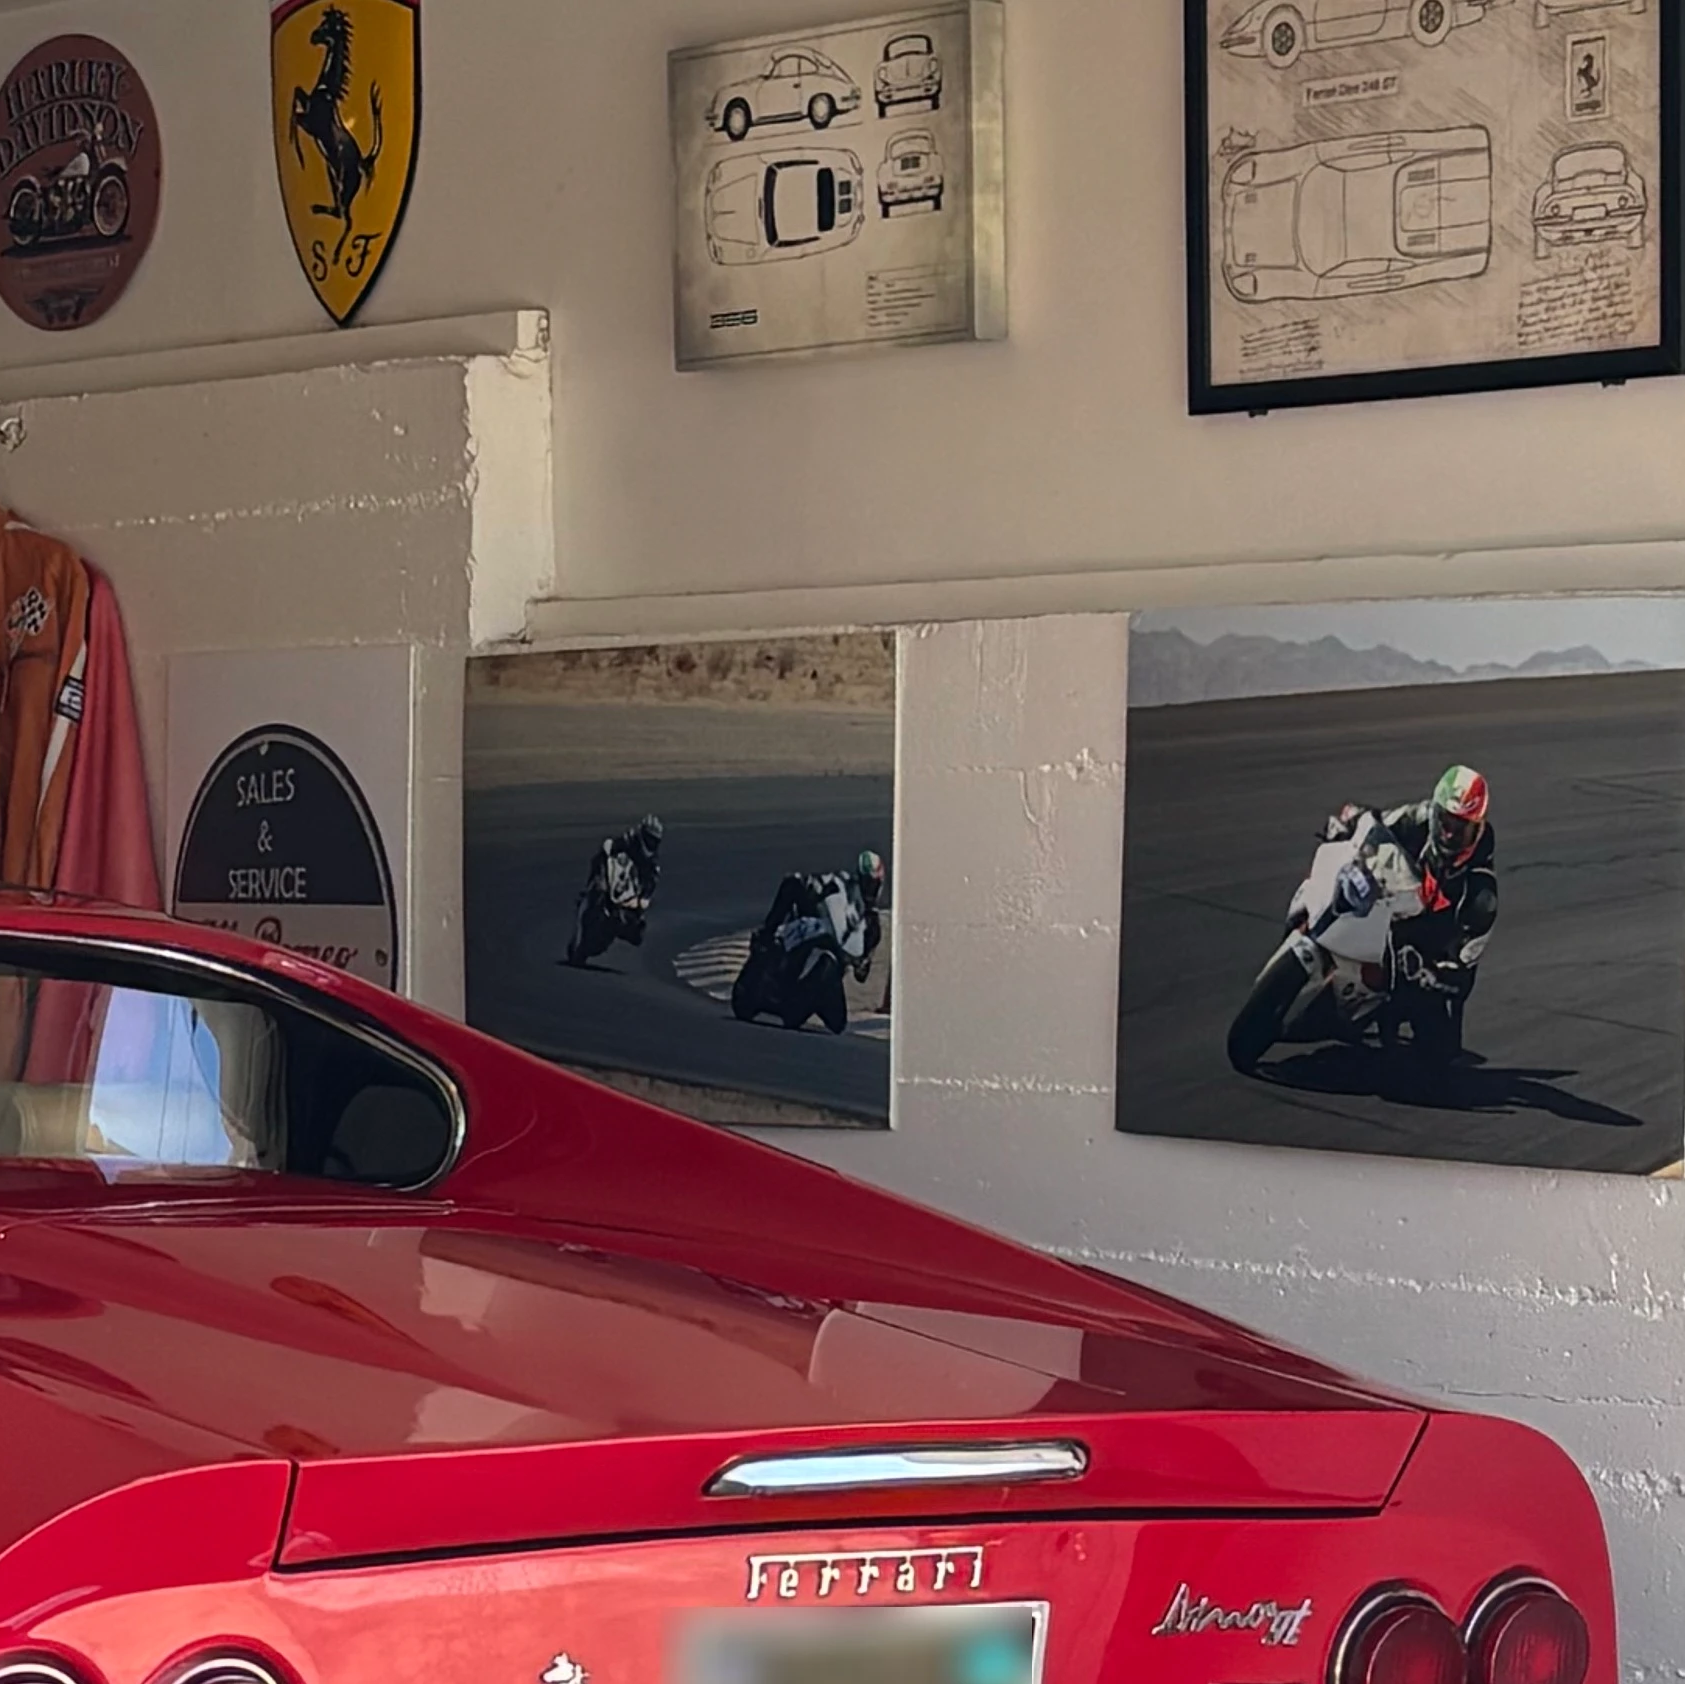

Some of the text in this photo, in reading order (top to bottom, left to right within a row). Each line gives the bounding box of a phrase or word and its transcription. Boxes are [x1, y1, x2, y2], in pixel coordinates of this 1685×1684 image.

[5, 58, 128, 122] HARLEY
[236, 768, 296, 807] SALES
[256, 819, 274, 853] &
[228, 867, 308, 899] SERVICE
[745, 1545, 986, 1601] Ferrari
